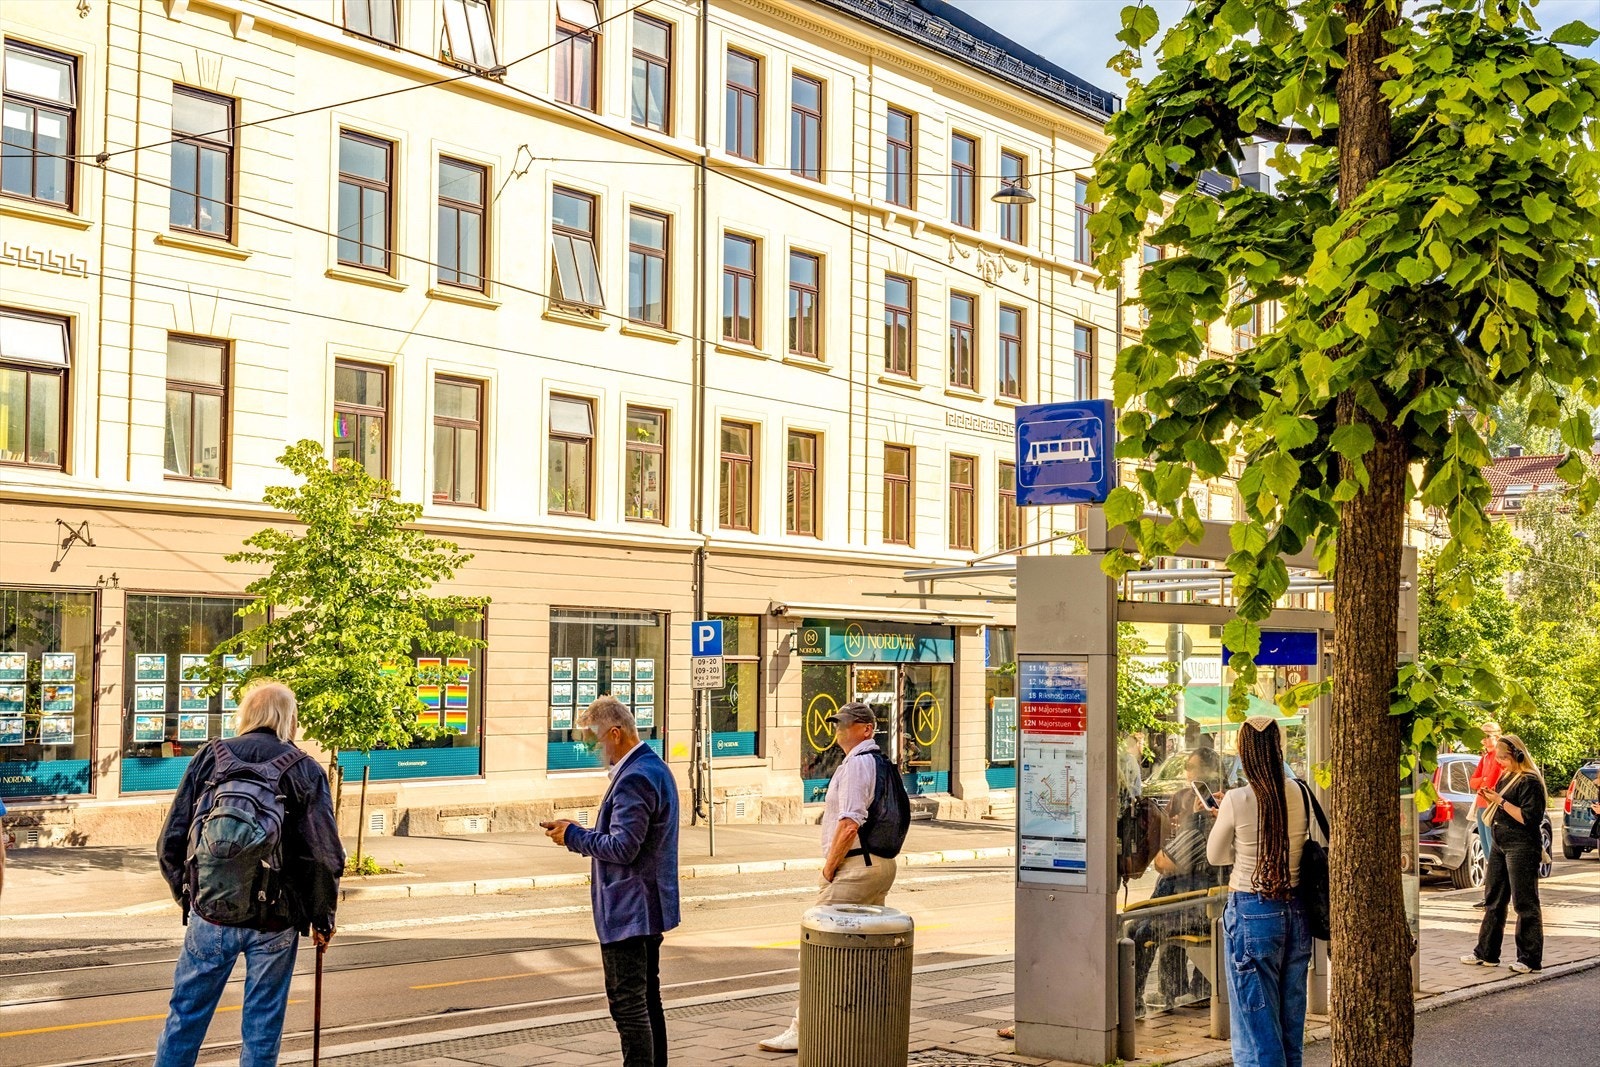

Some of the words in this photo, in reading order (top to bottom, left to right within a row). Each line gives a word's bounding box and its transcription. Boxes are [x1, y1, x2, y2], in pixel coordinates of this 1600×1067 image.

[699, 625, 715, 652] P
[867, 633, 916, 649] NORDVIK
[1039, 706, 1071, 714] Majorstuen
[1039, 720, 1071, 728] Majorstuen
[2, 775, 33, 783] NORDVIK
